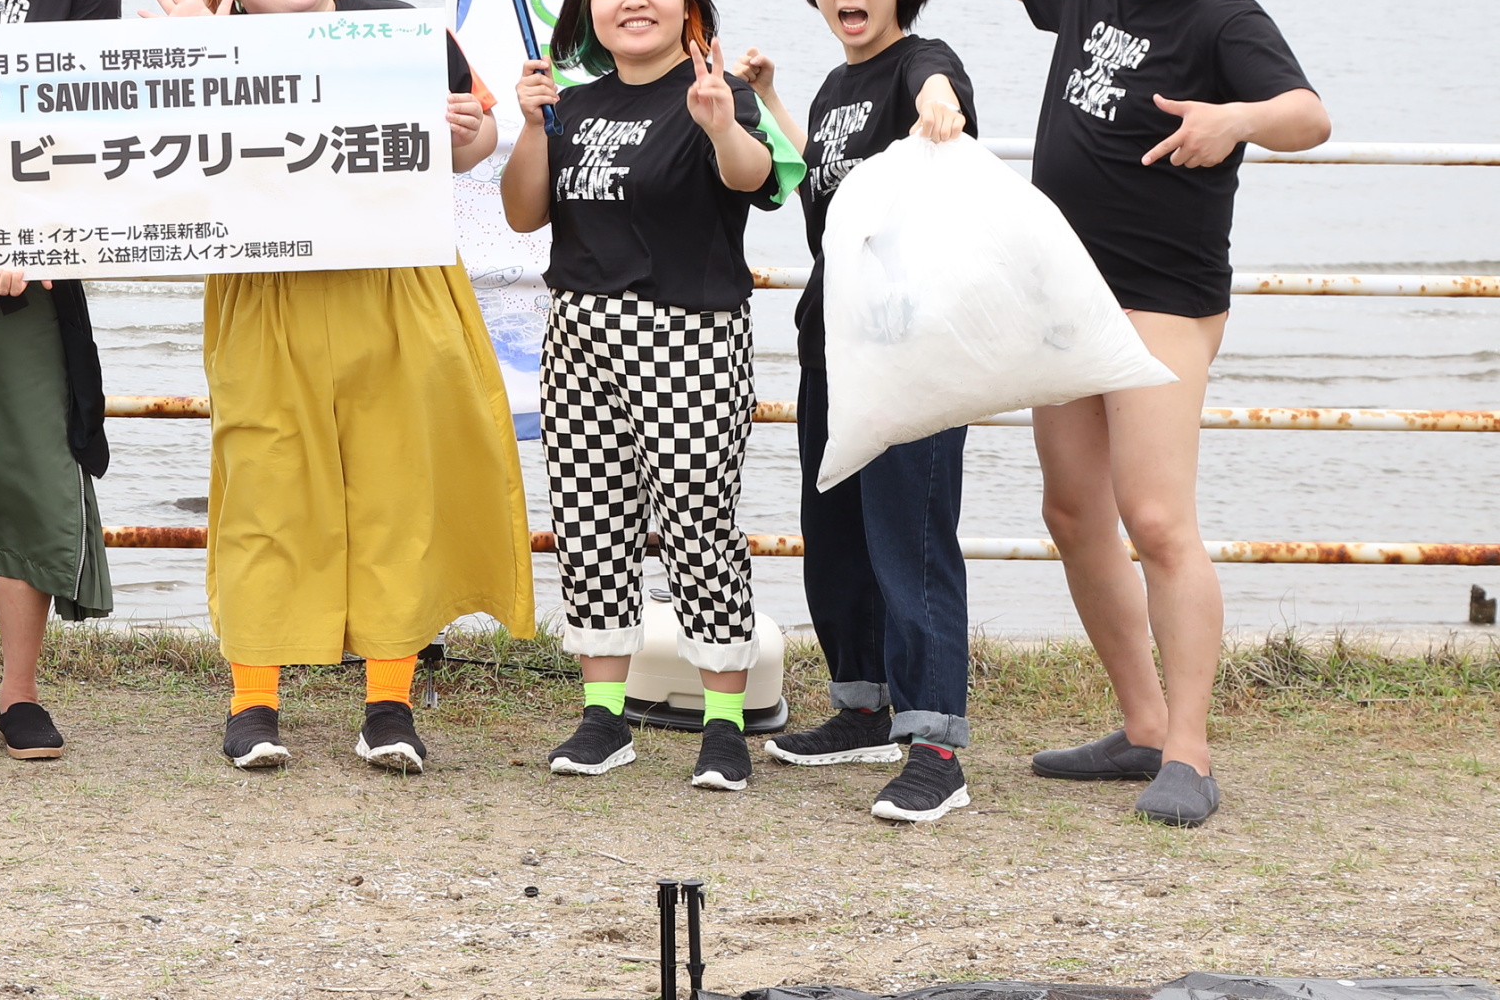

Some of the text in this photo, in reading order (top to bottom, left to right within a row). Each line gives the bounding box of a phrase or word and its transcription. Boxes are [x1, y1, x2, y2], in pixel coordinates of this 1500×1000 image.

[1083, 21, 1150, 70] SAVING
[145, 78, 195, 109] THE
[572, 117, 653, 145] SAVING
[11, 123, 430, 182] ビーチクリーン活動
[578, 145, 620, 167] THE
[821, 135, 848, 165] THE
[556, 166, 631, 202] PLANET
